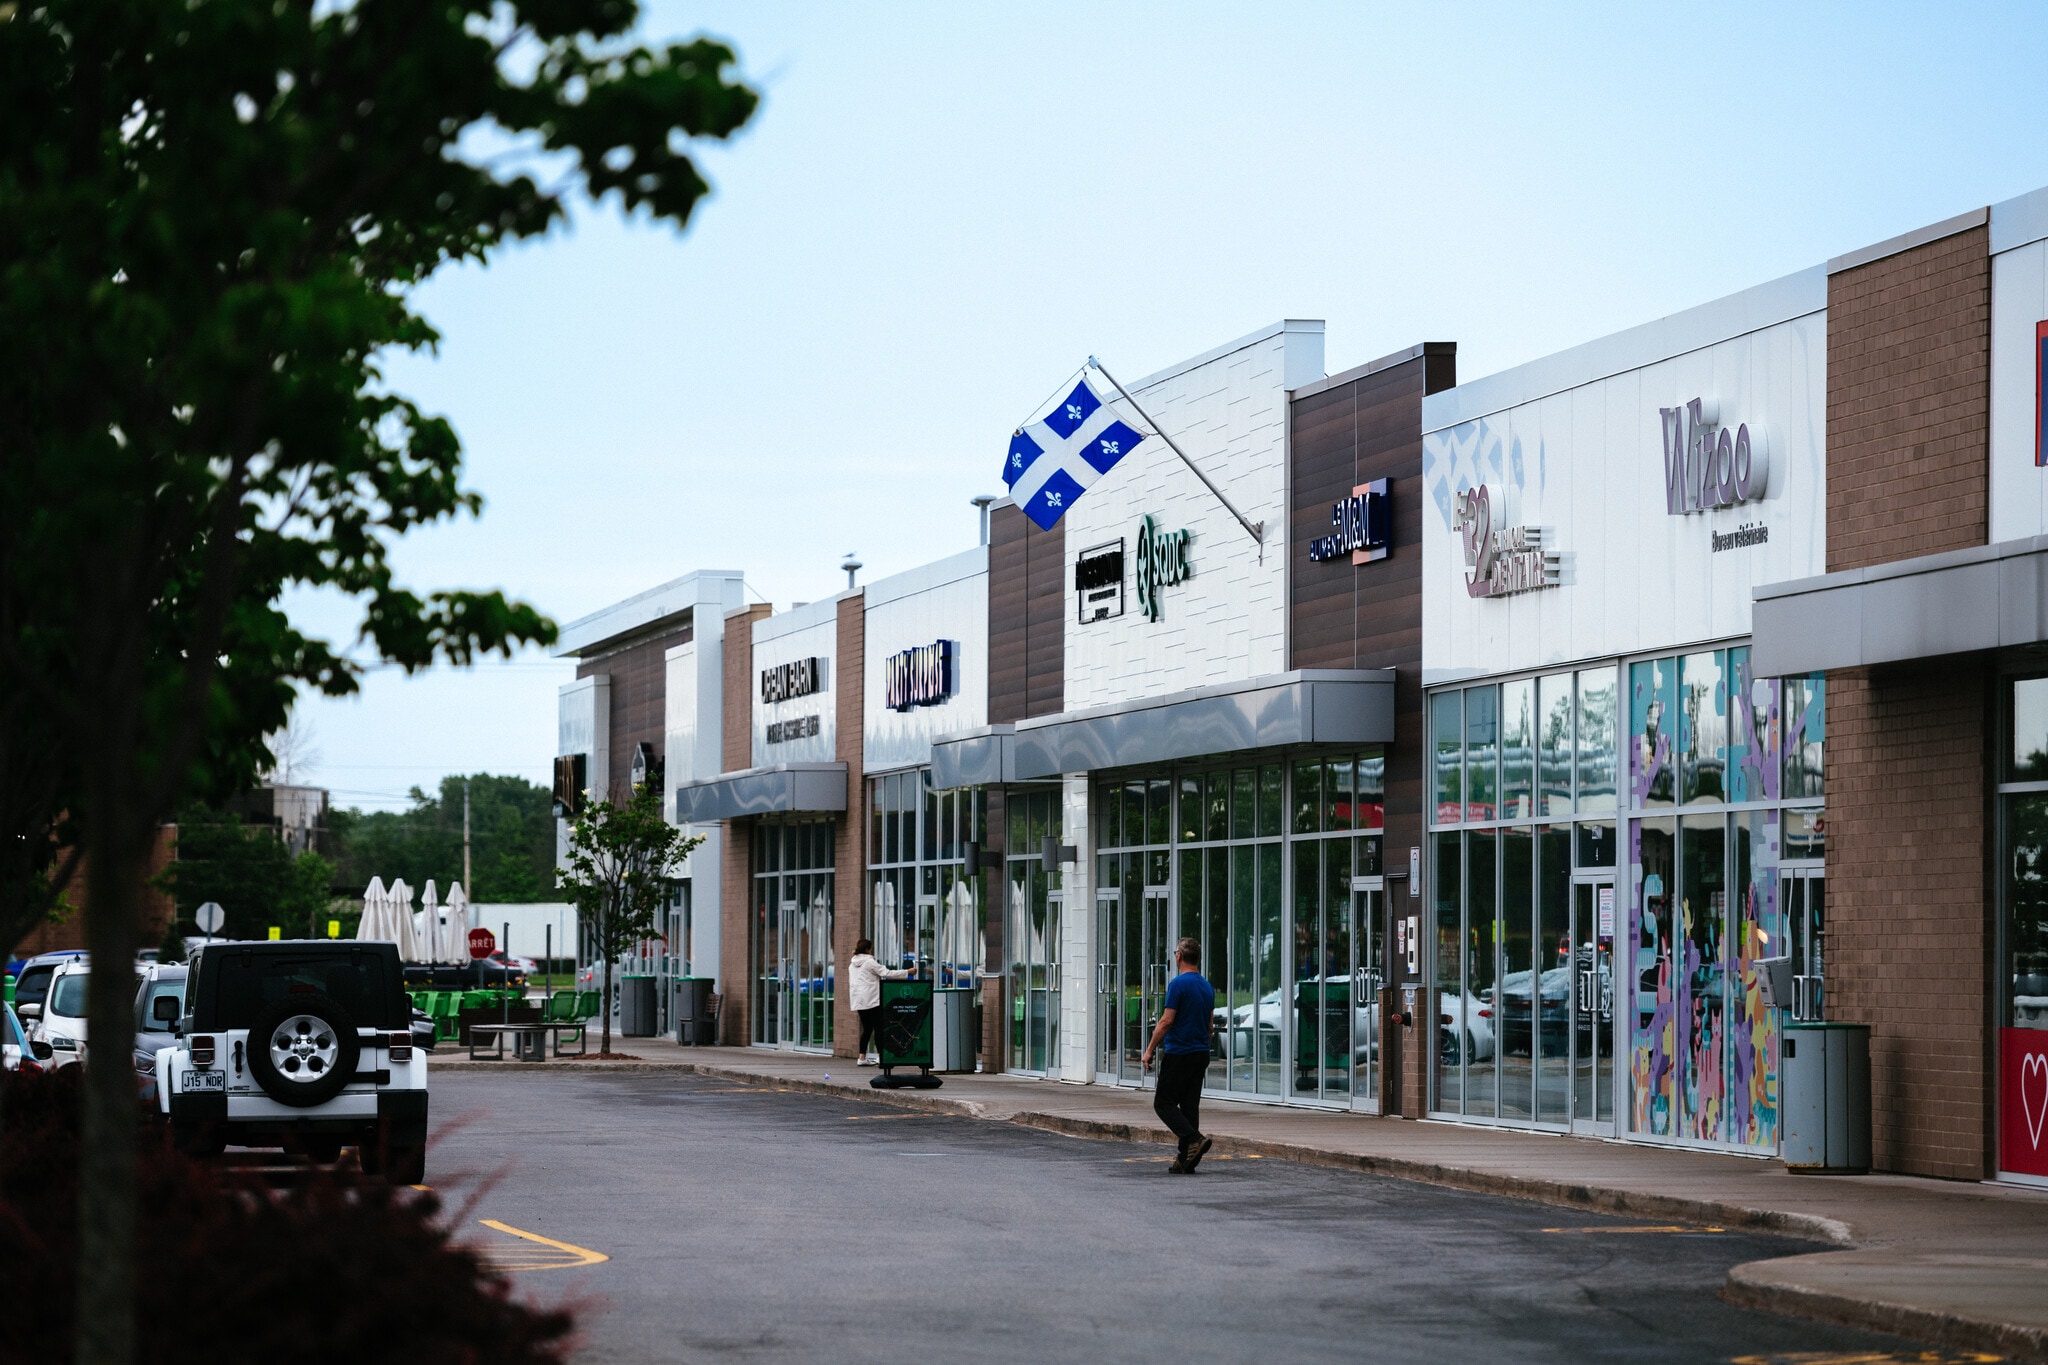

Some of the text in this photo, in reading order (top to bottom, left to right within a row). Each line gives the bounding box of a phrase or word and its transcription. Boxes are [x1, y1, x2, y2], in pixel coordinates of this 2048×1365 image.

[1660, 397, 1755, 515] Wizoo
[1310, 493, 1370, 561] ALIMENT M&M
[1463, 484, 1495, 598] 32
[1712, 521, 1768, 553] Bureau vétérinaire
[1153, 529, 1187, 586] SQDC
[1492, 551, 1548, 594] DENTAIRE
[762, 658, 814, 704] URBAN BARN
[184, 1075, 223, 1087] J15 NDR
